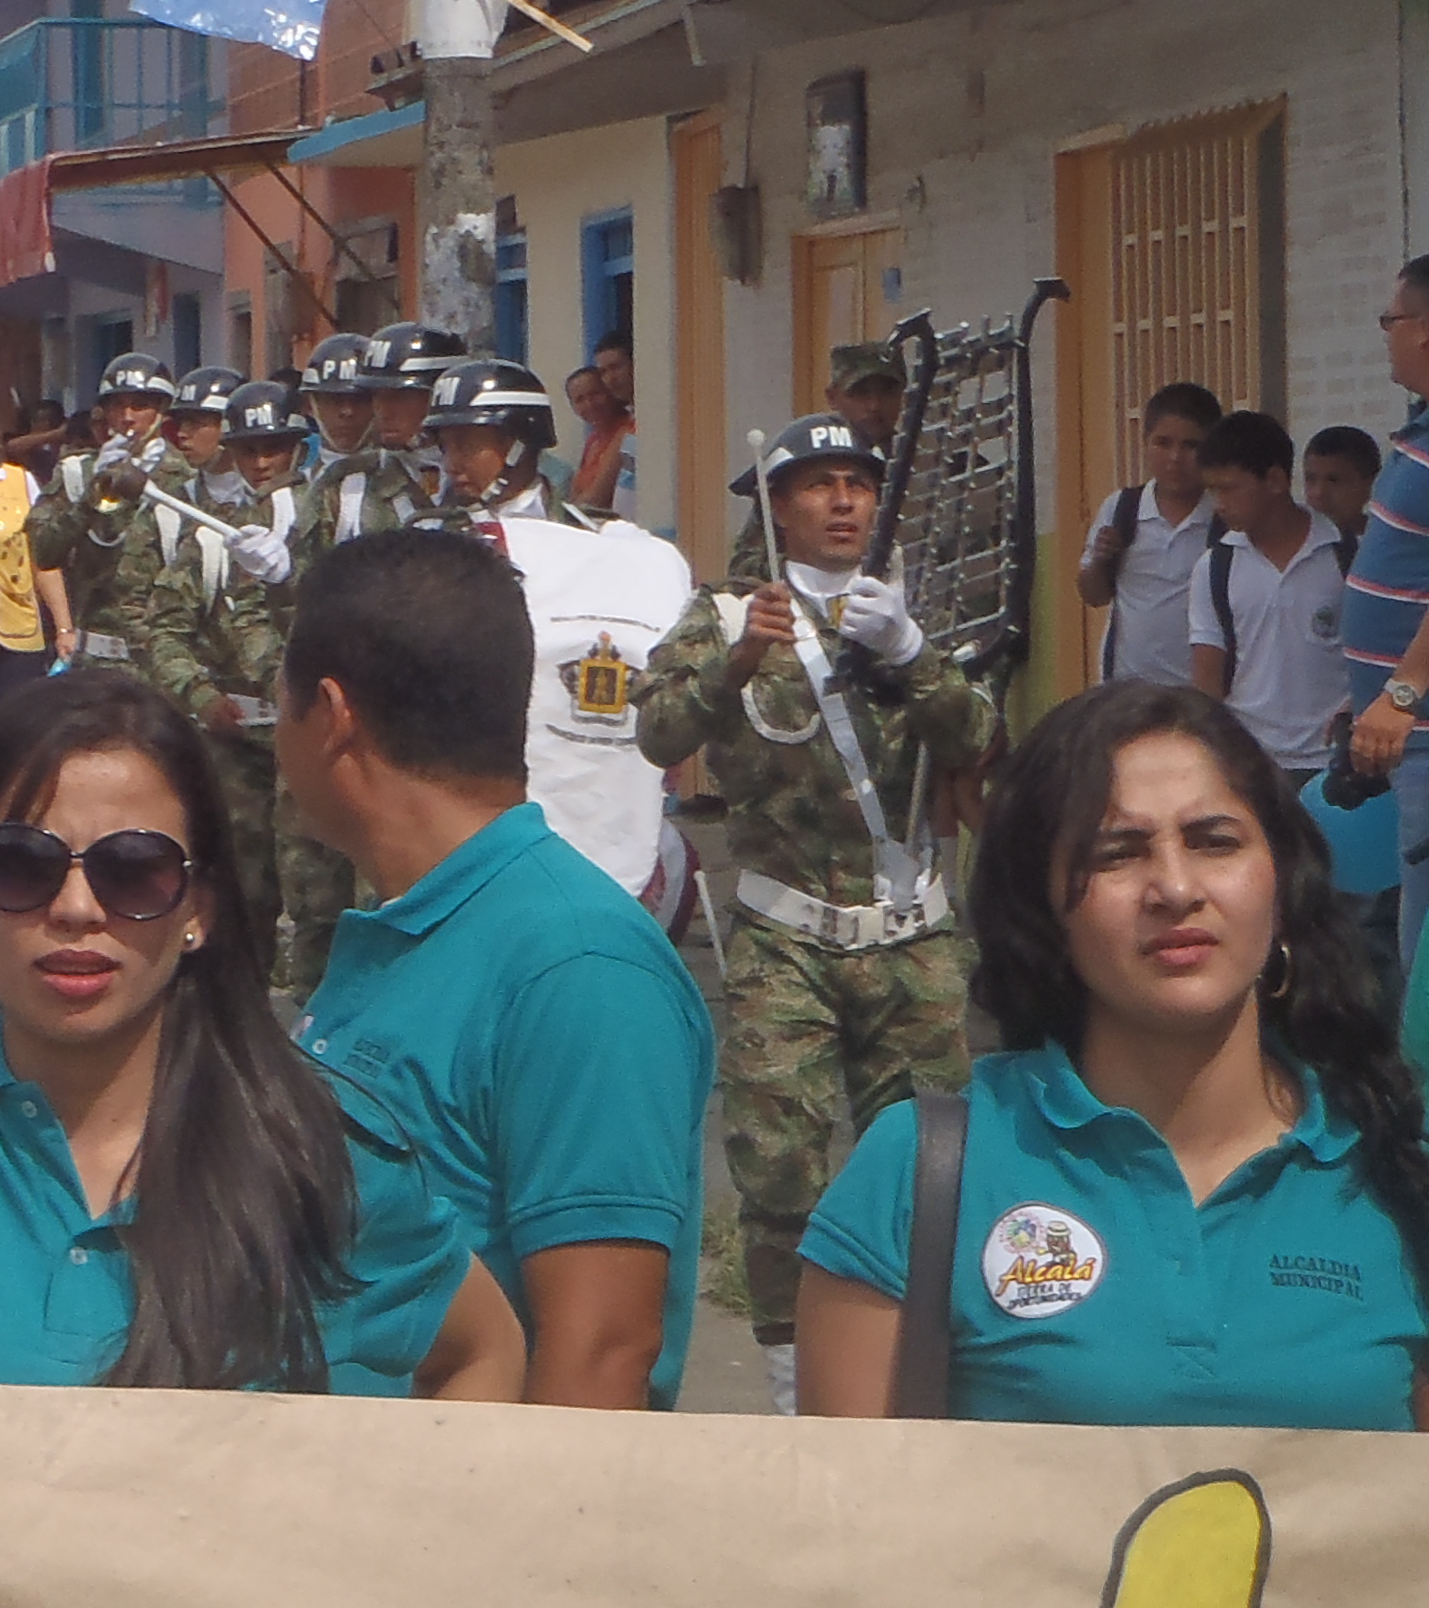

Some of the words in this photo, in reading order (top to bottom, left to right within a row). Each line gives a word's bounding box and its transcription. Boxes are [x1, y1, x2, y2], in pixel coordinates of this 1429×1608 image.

[115, 370, 146, 389] PM
[322, 359, 357, 381] PM
[244, 402, 274, 428] PM
[810, 425, 853, 449] PM
